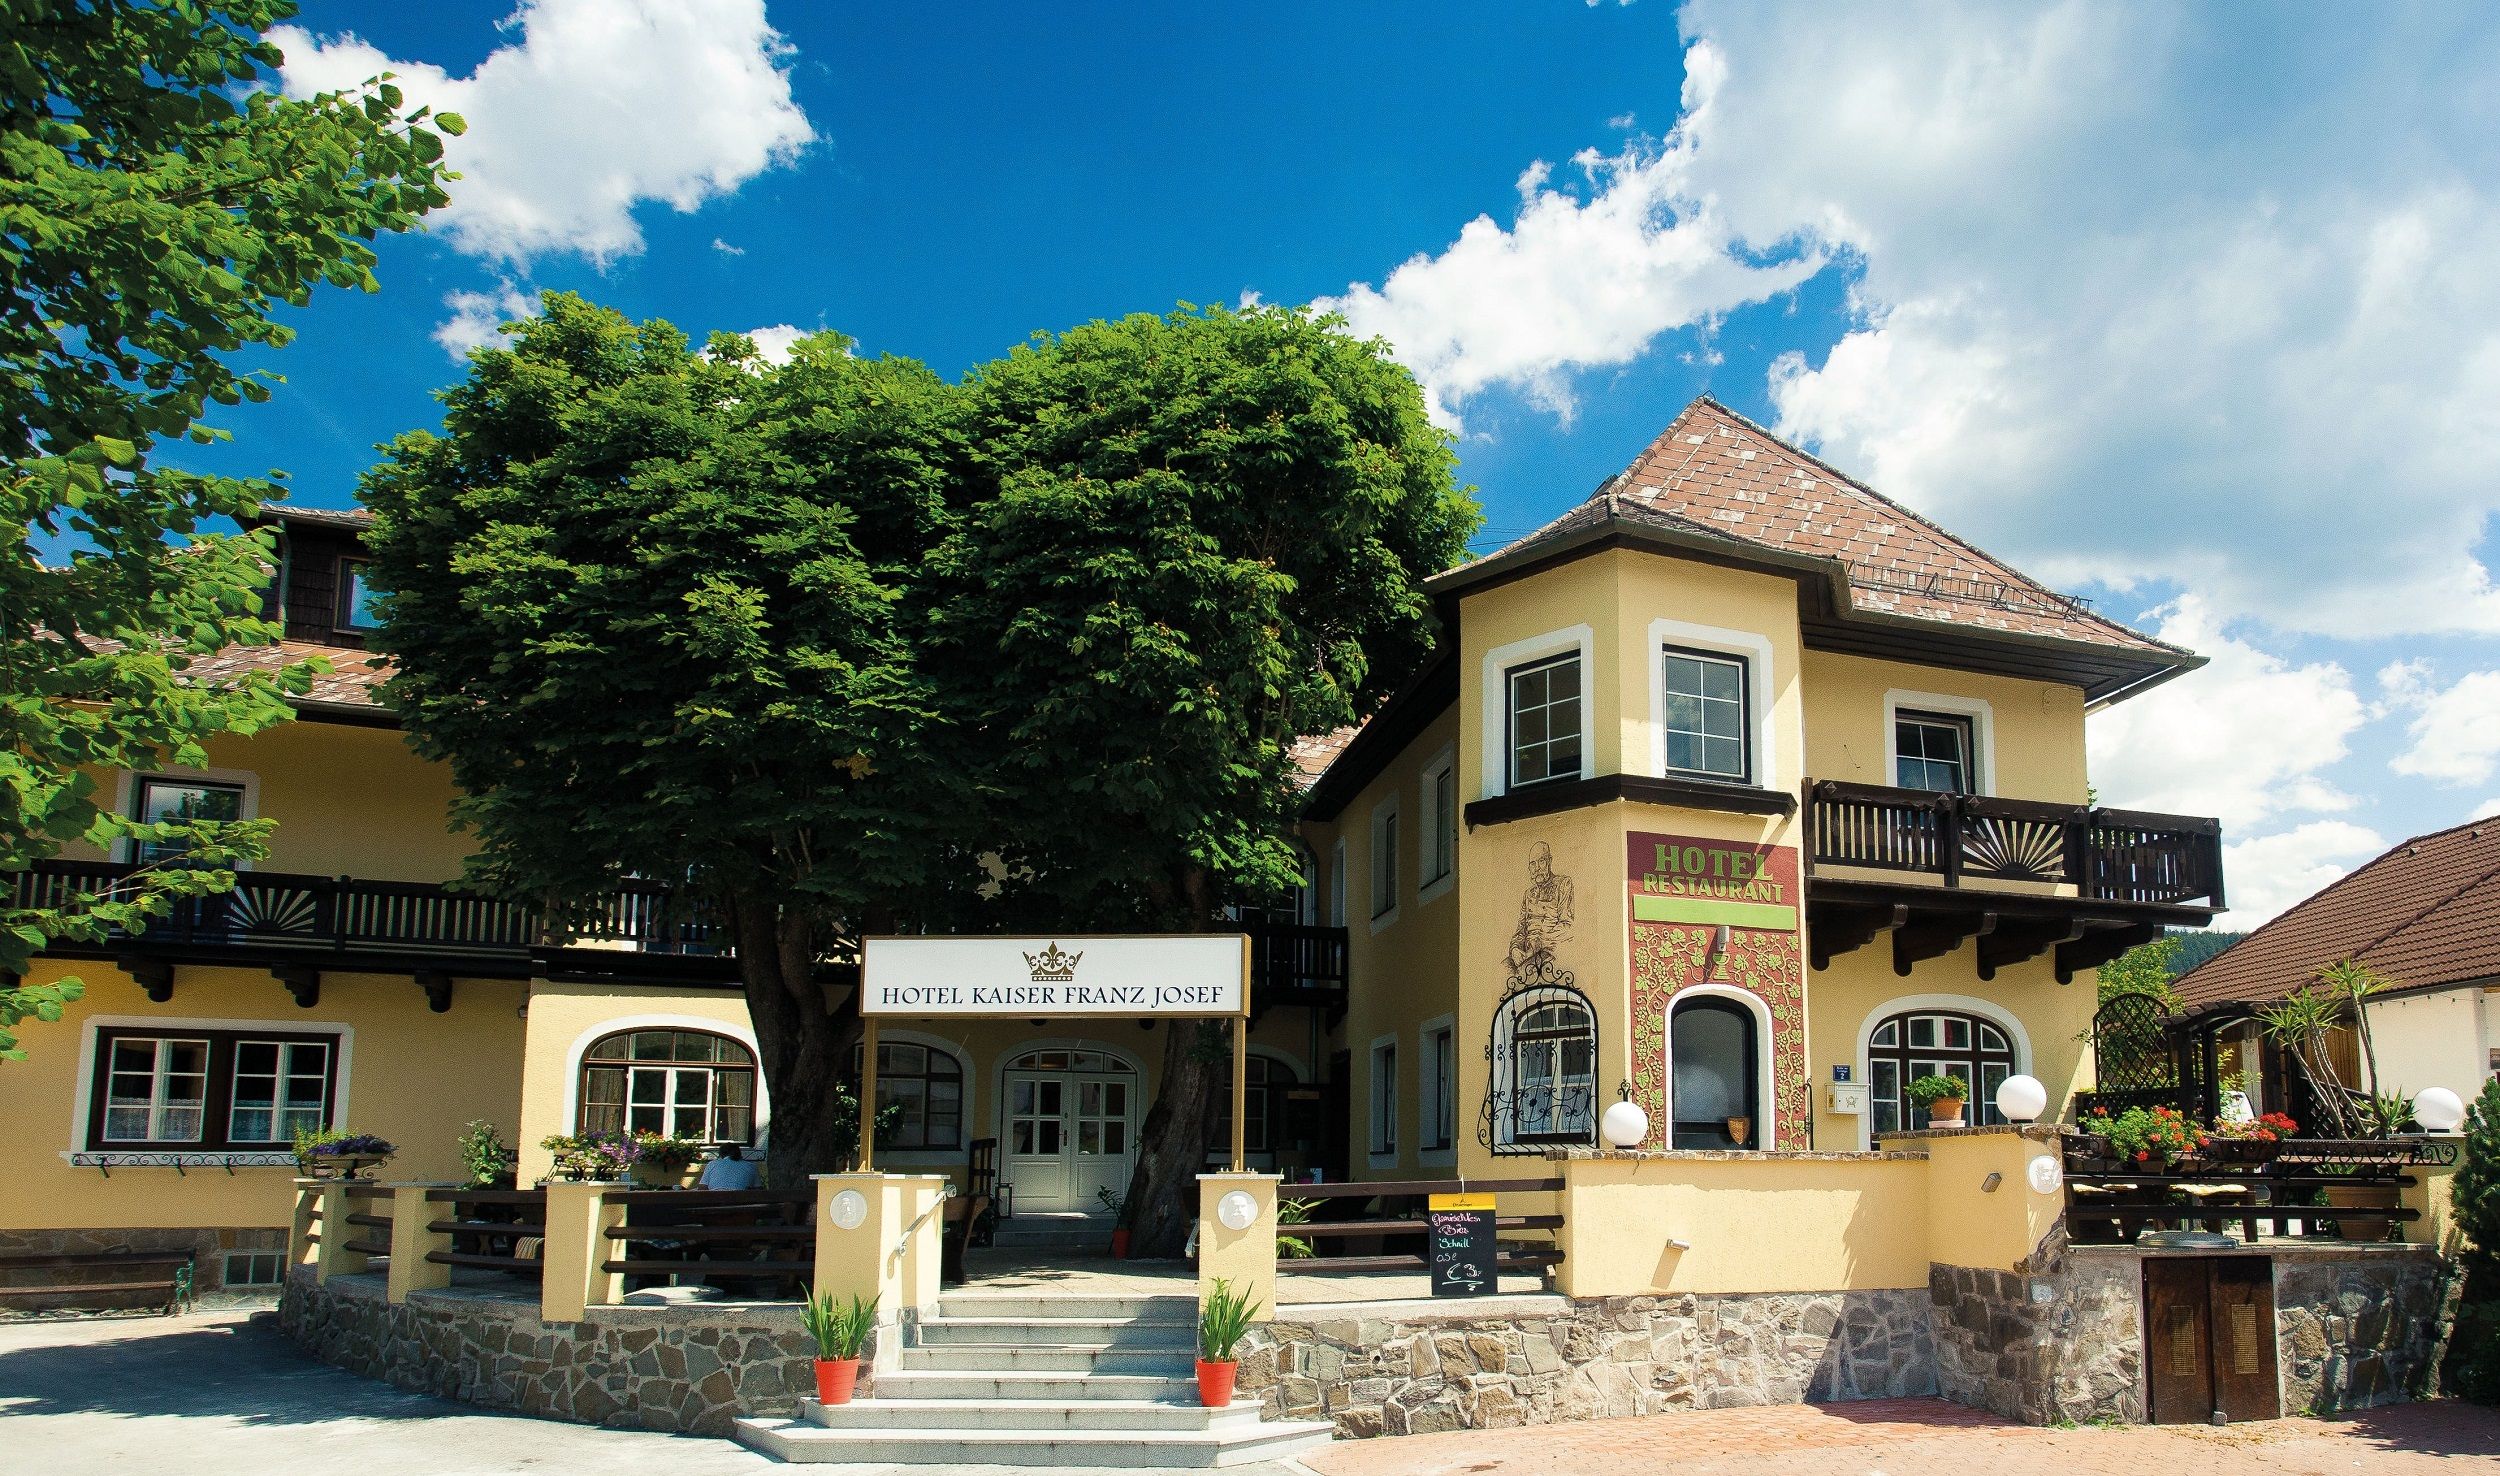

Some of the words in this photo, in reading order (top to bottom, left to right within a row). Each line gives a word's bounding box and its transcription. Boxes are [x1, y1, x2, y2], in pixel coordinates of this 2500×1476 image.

[1654, 842, 1774, 881] HOTEL
[1642, 872, 1784, 903] RESTAURANT
[881, 987, 964, 1004] HOTEL
[972, 986, 1056, 1004] KAISER
[1064, 986, 1145, 1004] FRANZ
[1150, 986, 1224, 1009] JOSEF
[1840, 1072, 1845, 1080] 2
